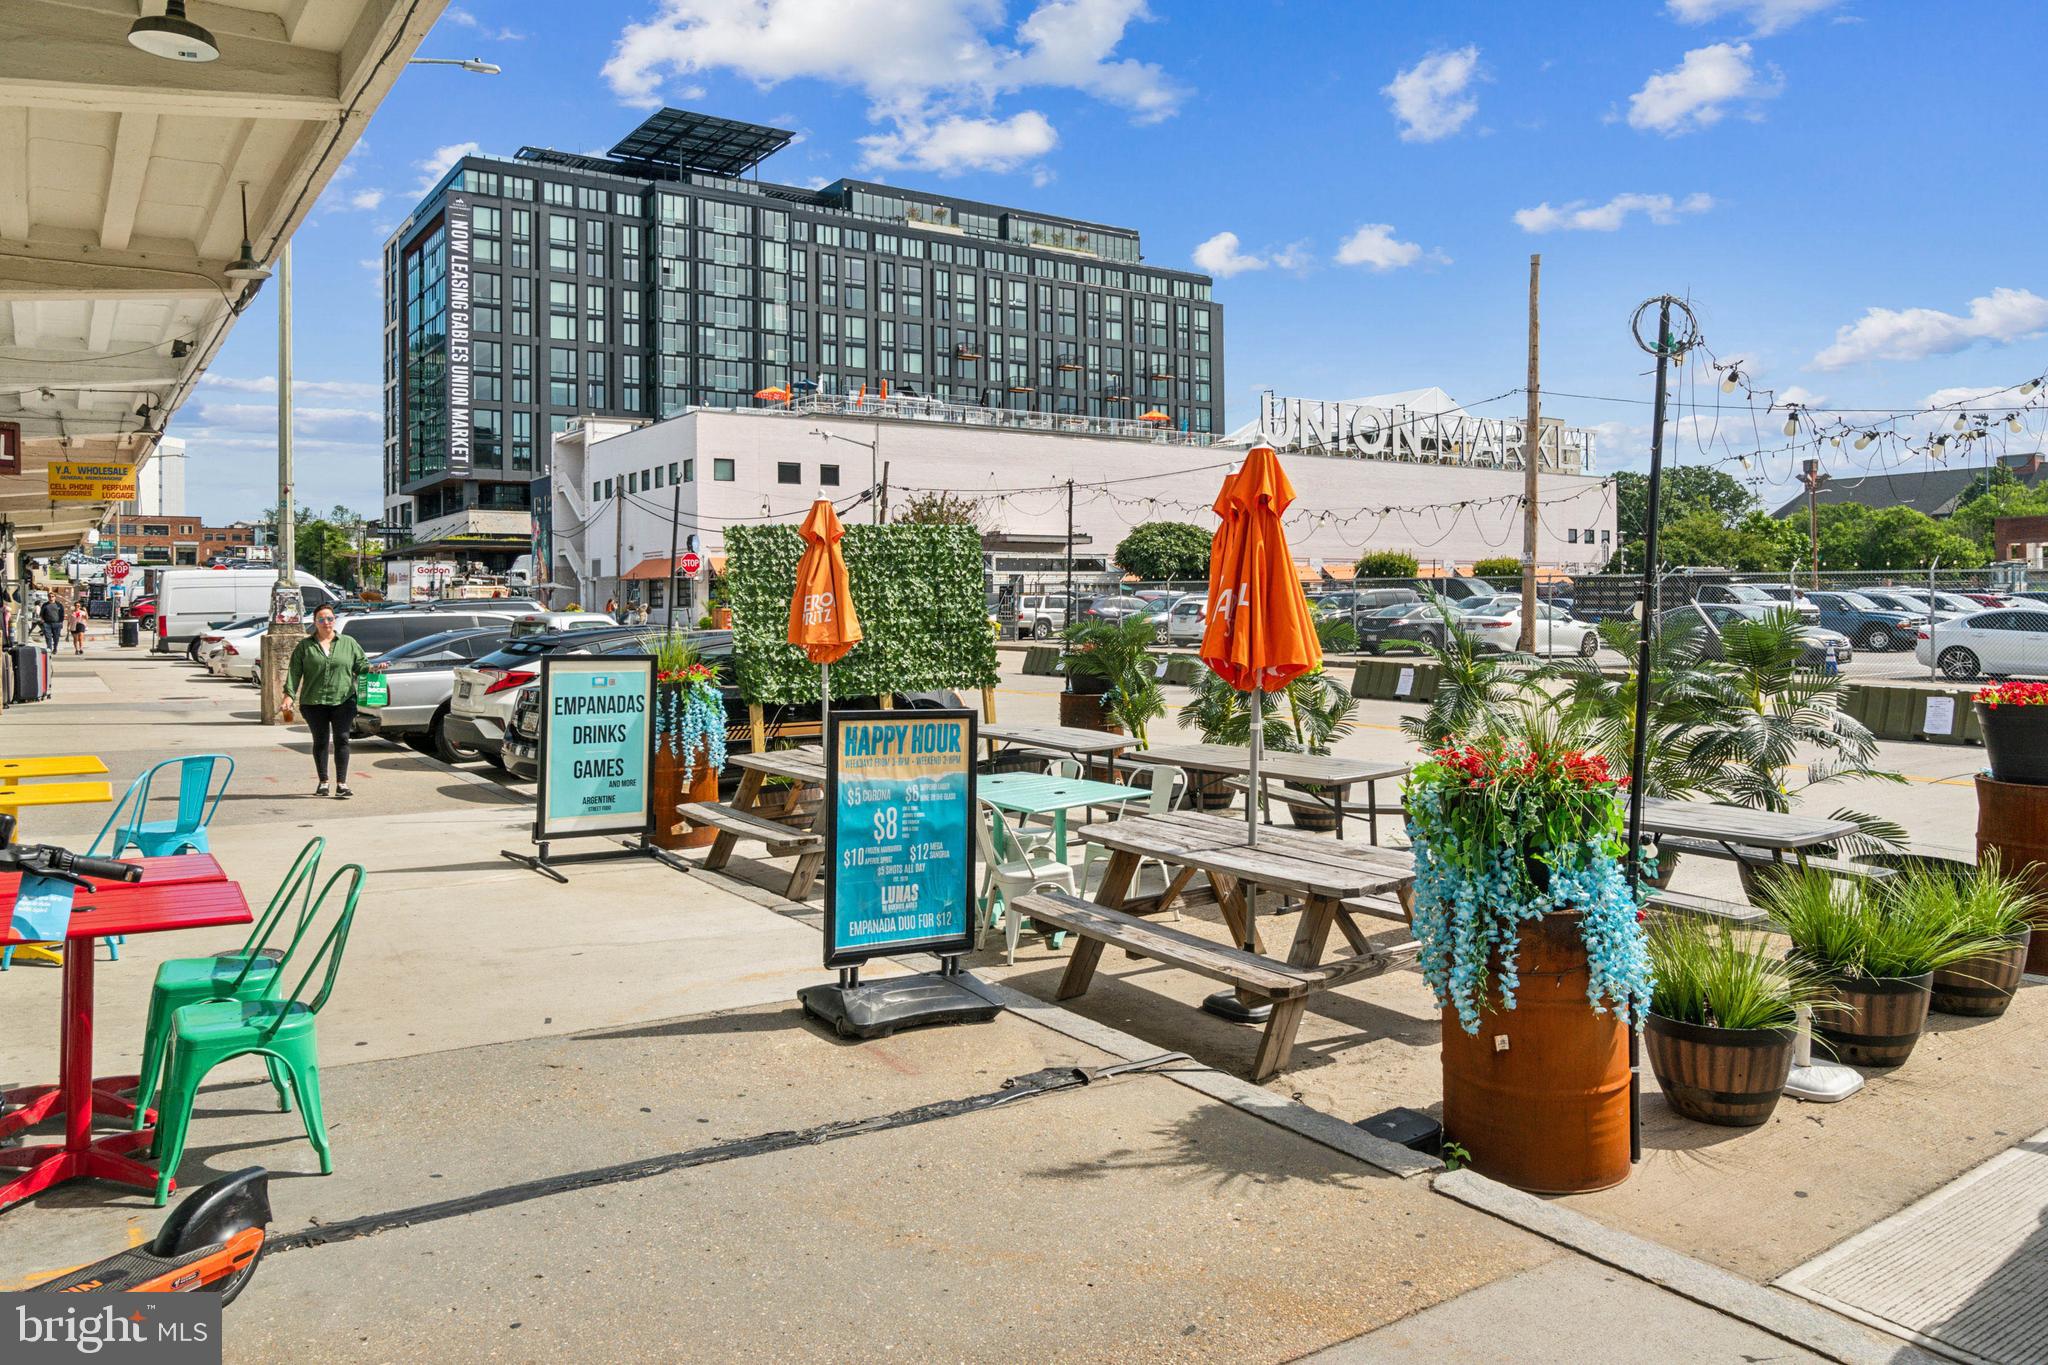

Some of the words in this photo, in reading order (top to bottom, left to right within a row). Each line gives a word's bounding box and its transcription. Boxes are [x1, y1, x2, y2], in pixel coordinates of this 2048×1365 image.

[451, 220, 468, 254] NOW
[451, 255, 468, 310] LEASING
[451, 312, 468, 363] GABLES
[451, 365, 469, 406] UNION
[451, 408, 469, 463] MARKET
[1261, 391, 1422, 464] UNION
[56, 466, 71, 475] Y.A.
[78, 466, 128, 475] WHOLESALE
[69, 483, 94, 491] PHONE
[107, 565, 128, 574] STOP
[682, 559, 699, 567] STOP
[554, 694, 645, 715] EMPANADAS
[573, 724, 626, 745] DRINKS
[844, 724, 908, 756] HAPPY
[911, 723, 961, 754] HOUR
[573, 758, 624, 779] GAMES
[608, 780, 620, 788] AND
[622, 779, 637, 787] MORE
[582, 795, 616, 804] ARGENTINE
[848, 786, 861, 807] $5
[873, 807, 898, 844] $8
[844, 847, 865, 869] $10
[910, 843, 929, 862] $12
[885, 864, 903, 875] SHOTS
[904, 863, 914, 873] ALL
[915, 862, 926, 872] DAY
[881, 883, 919, 904] LUNAS
[849, 917, 896, 936] EMPANADA
[898, 915, 916, 931] DUO
[918, 913, 934, 928] FOR
[936, 911, 952, 927] $12
